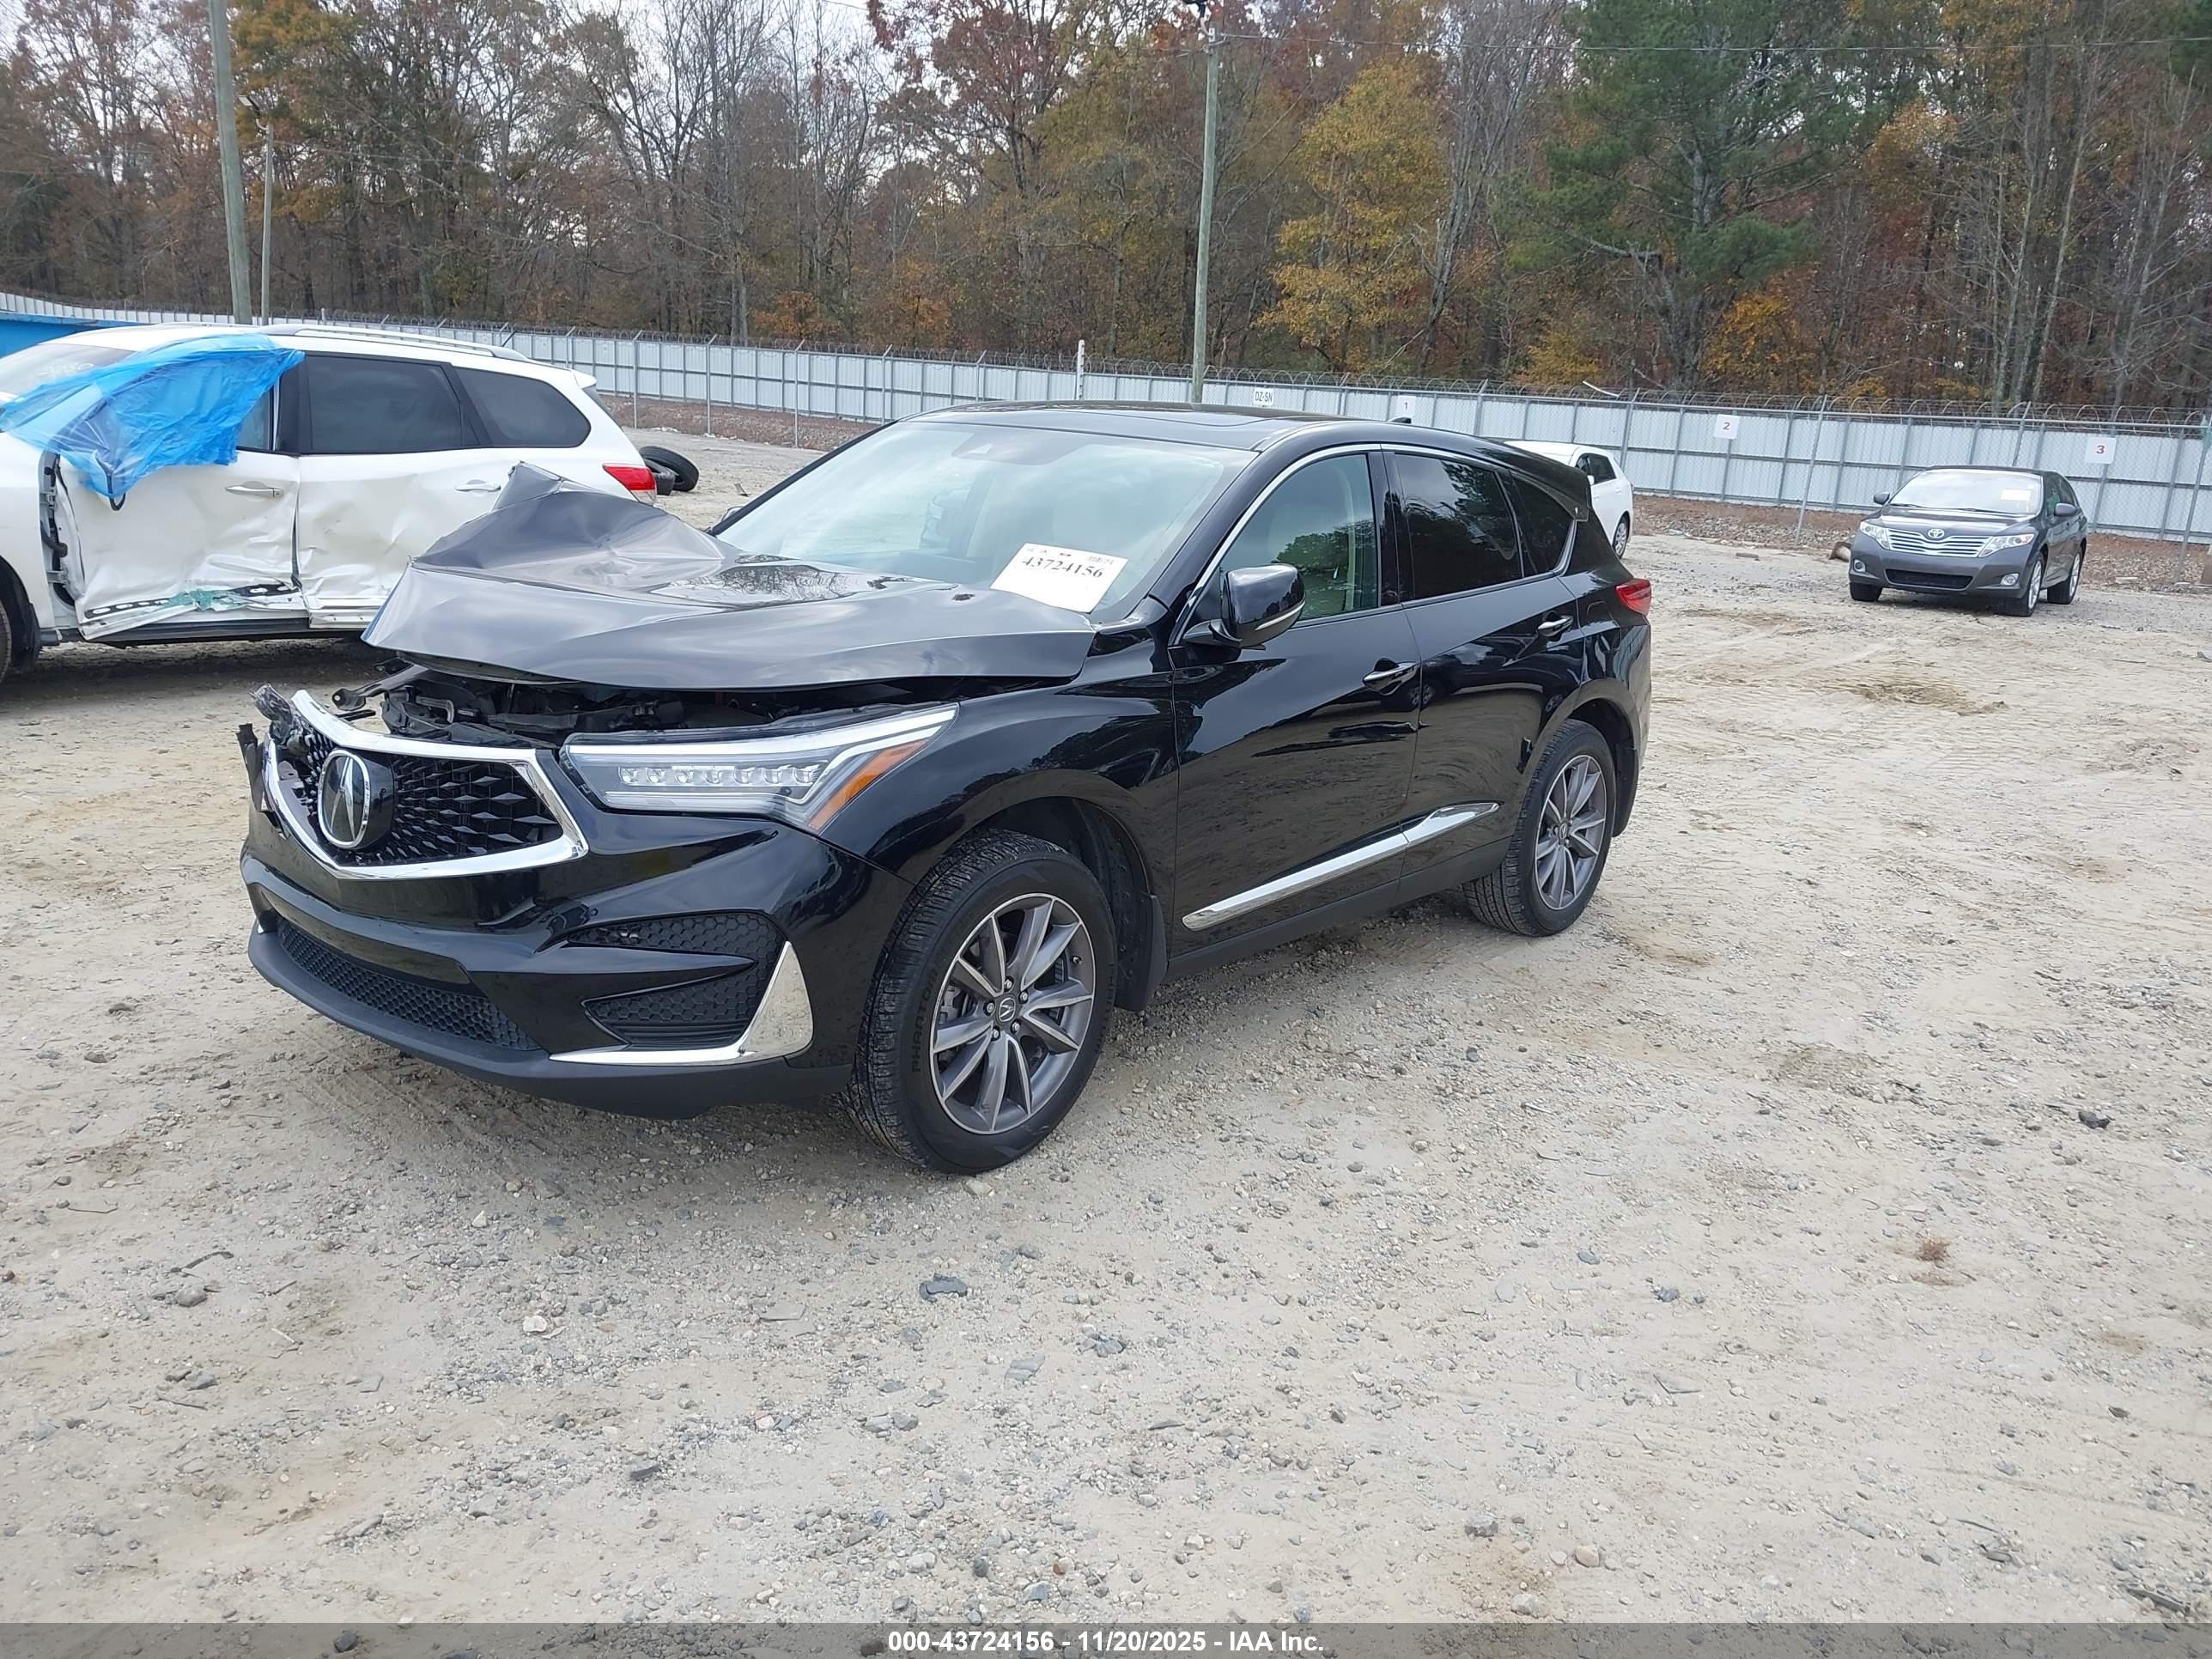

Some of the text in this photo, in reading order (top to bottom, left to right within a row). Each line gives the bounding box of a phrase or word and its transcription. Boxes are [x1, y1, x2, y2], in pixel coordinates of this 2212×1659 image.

[1254, 390, 1273, 404] DZ-SN
[1722, 421, 1731, 431] 2
[2095, 444, 2106, 454] 3
[1021, 556, 1105, 578] 43724156
